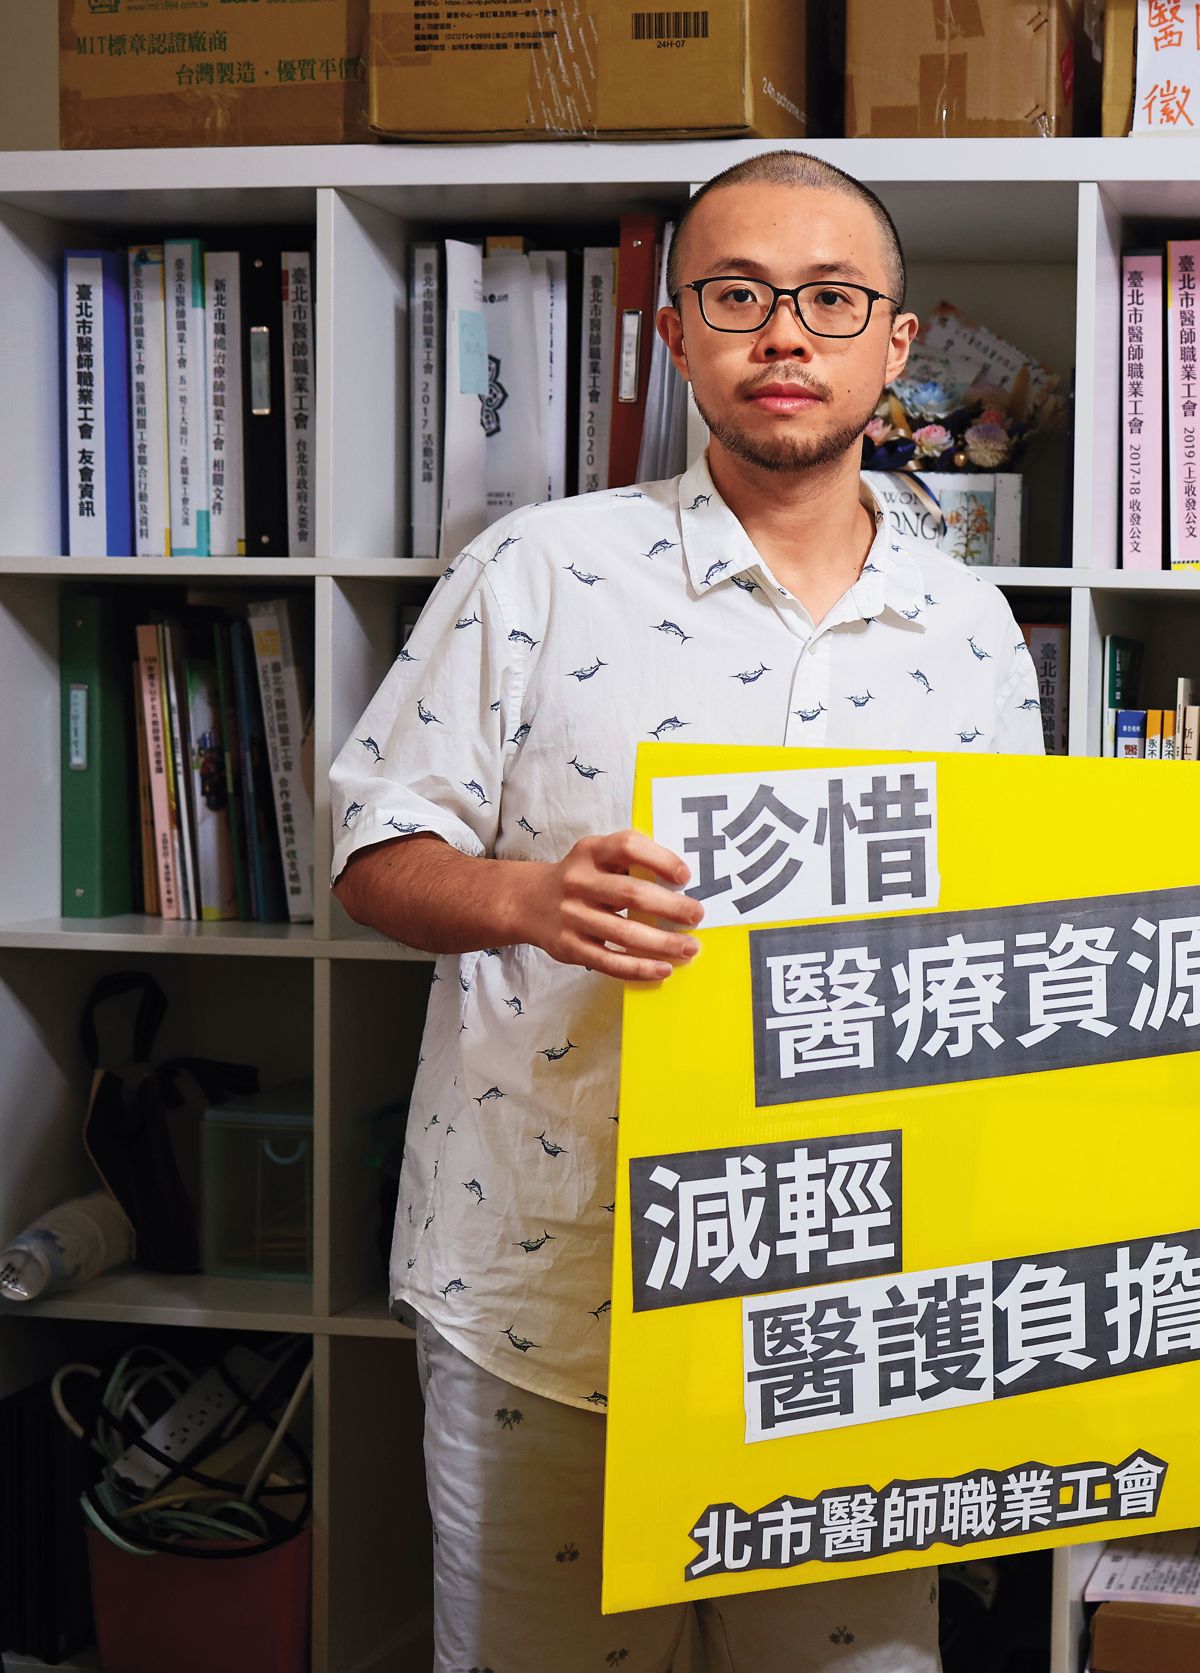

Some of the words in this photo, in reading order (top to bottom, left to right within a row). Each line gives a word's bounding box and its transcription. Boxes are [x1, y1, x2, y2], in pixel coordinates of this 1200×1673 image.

[657, 40, 685, 48] 24H-07
[75, 284, 94, 441] 臺北市醫師職業工會
[291, 267, 309, 431] 臺北市醫師職業工會
[1127, 270, 1144, 434] 臺北市醫師職業工會
[1178, 255, 1197, 417] 臺北市醫師職業工會
[421, 382, 429, 429] 2017
[586, 411, 595, 466] 2020
[1129, 444, 1141, 495] 2017-18
[79, 448, 95, 517] 友會資訊
[681, 773, 933, 914] 珍惜
[643, 1142, 895, 1291] 減輕
[691, 1456, 1163, 1576] 北市醫師職業工會
